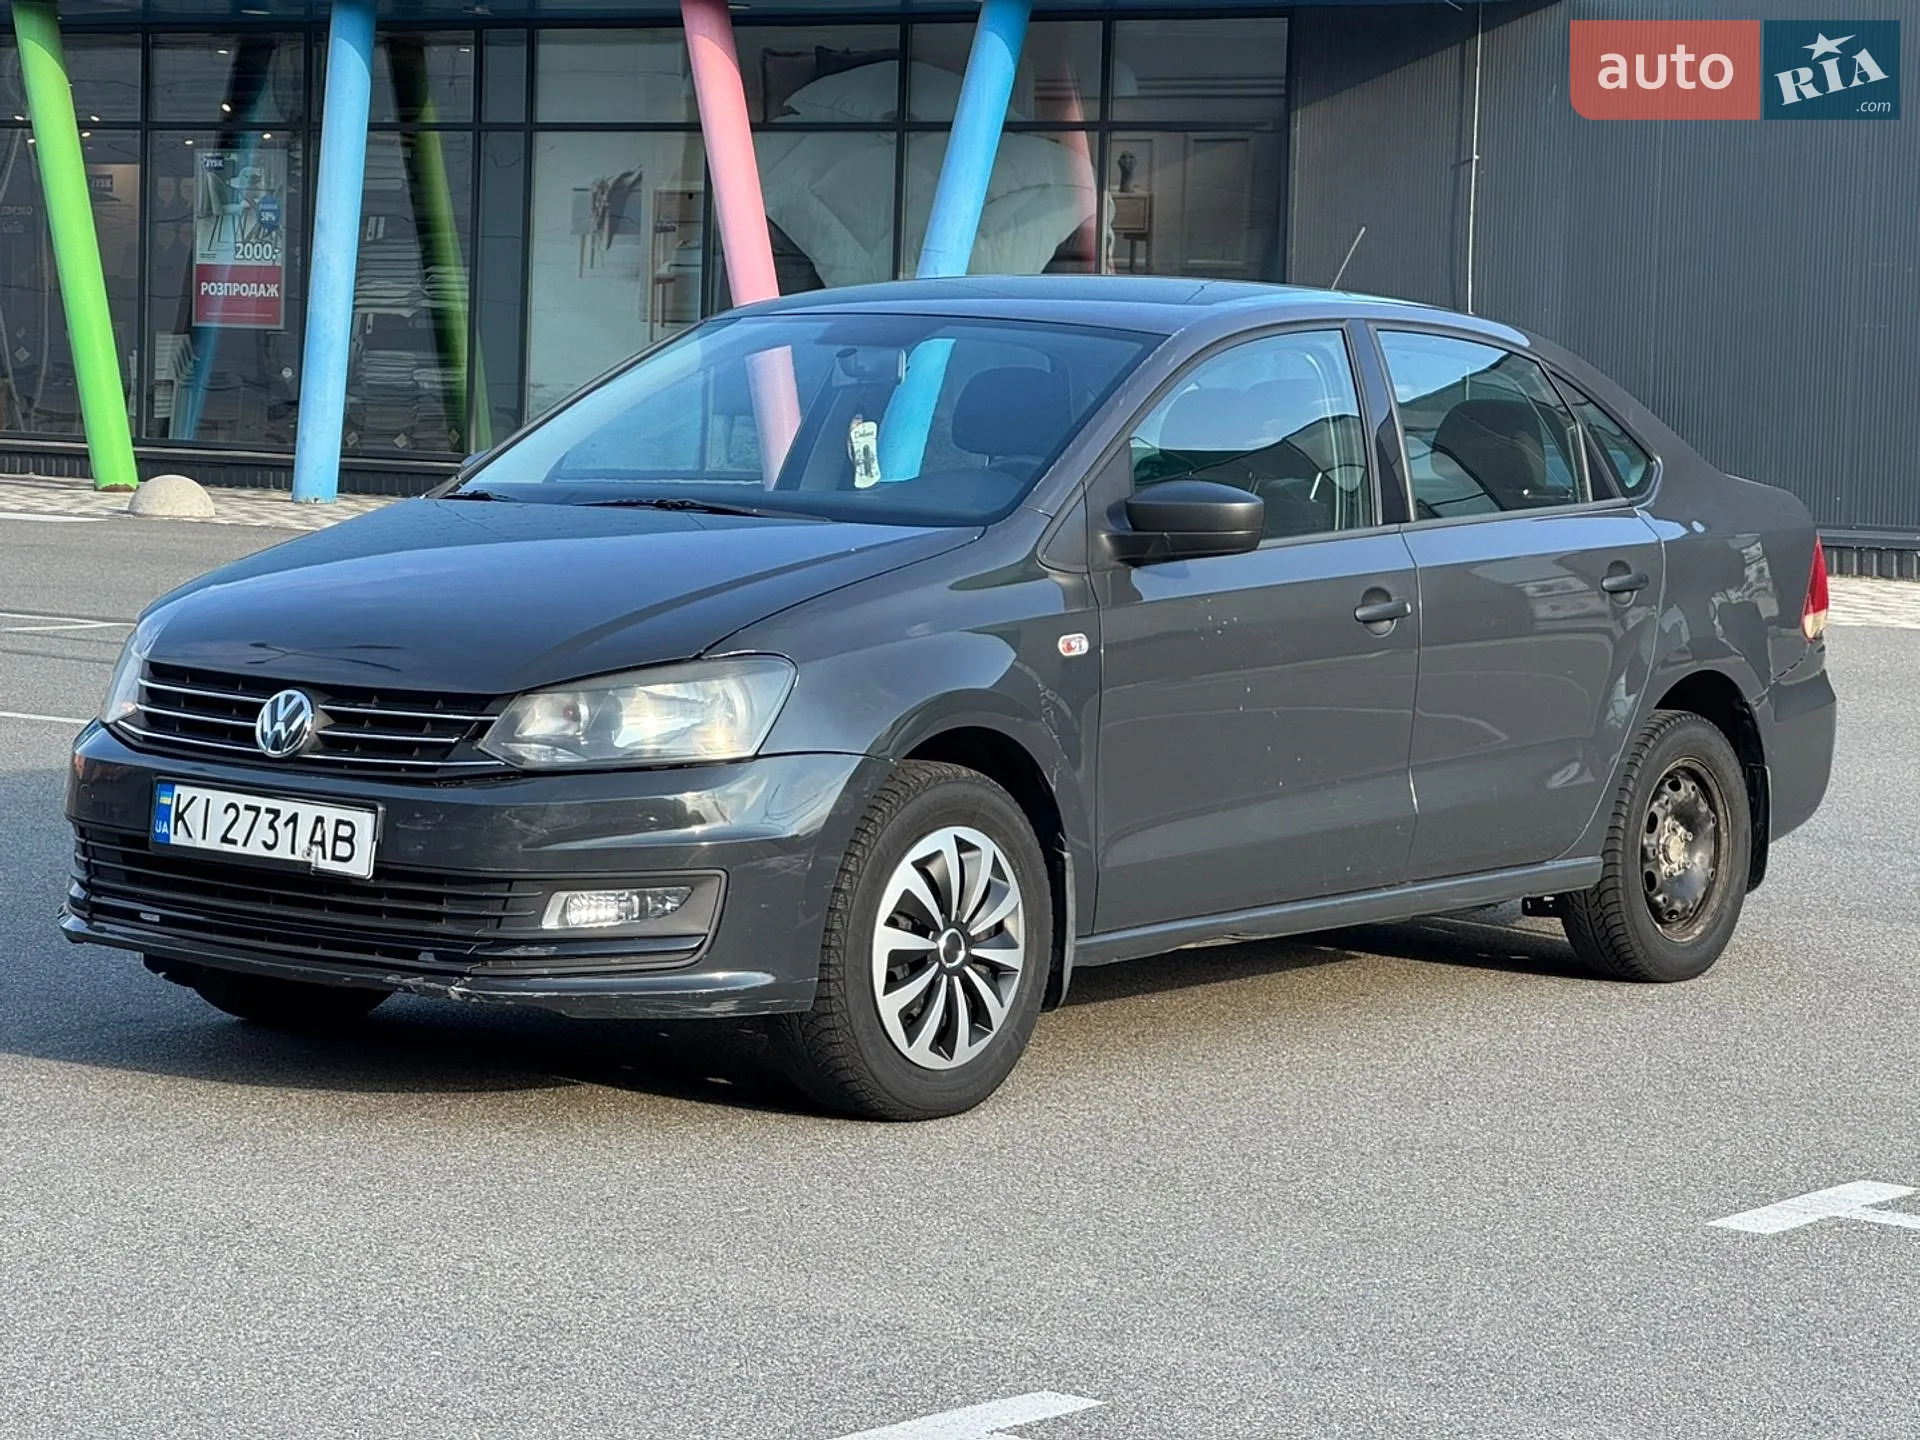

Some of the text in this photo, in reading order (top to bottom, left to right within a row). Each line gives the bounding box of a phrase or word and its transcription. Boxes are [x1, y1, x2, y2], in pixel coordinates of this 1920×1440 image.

[201, 282, 279, 297] РОЗПРОДАЖ
[155, 820, 169, 835] UA
[220, 802, 299, 855] 2731
[308, 815, 357, 863] AB
